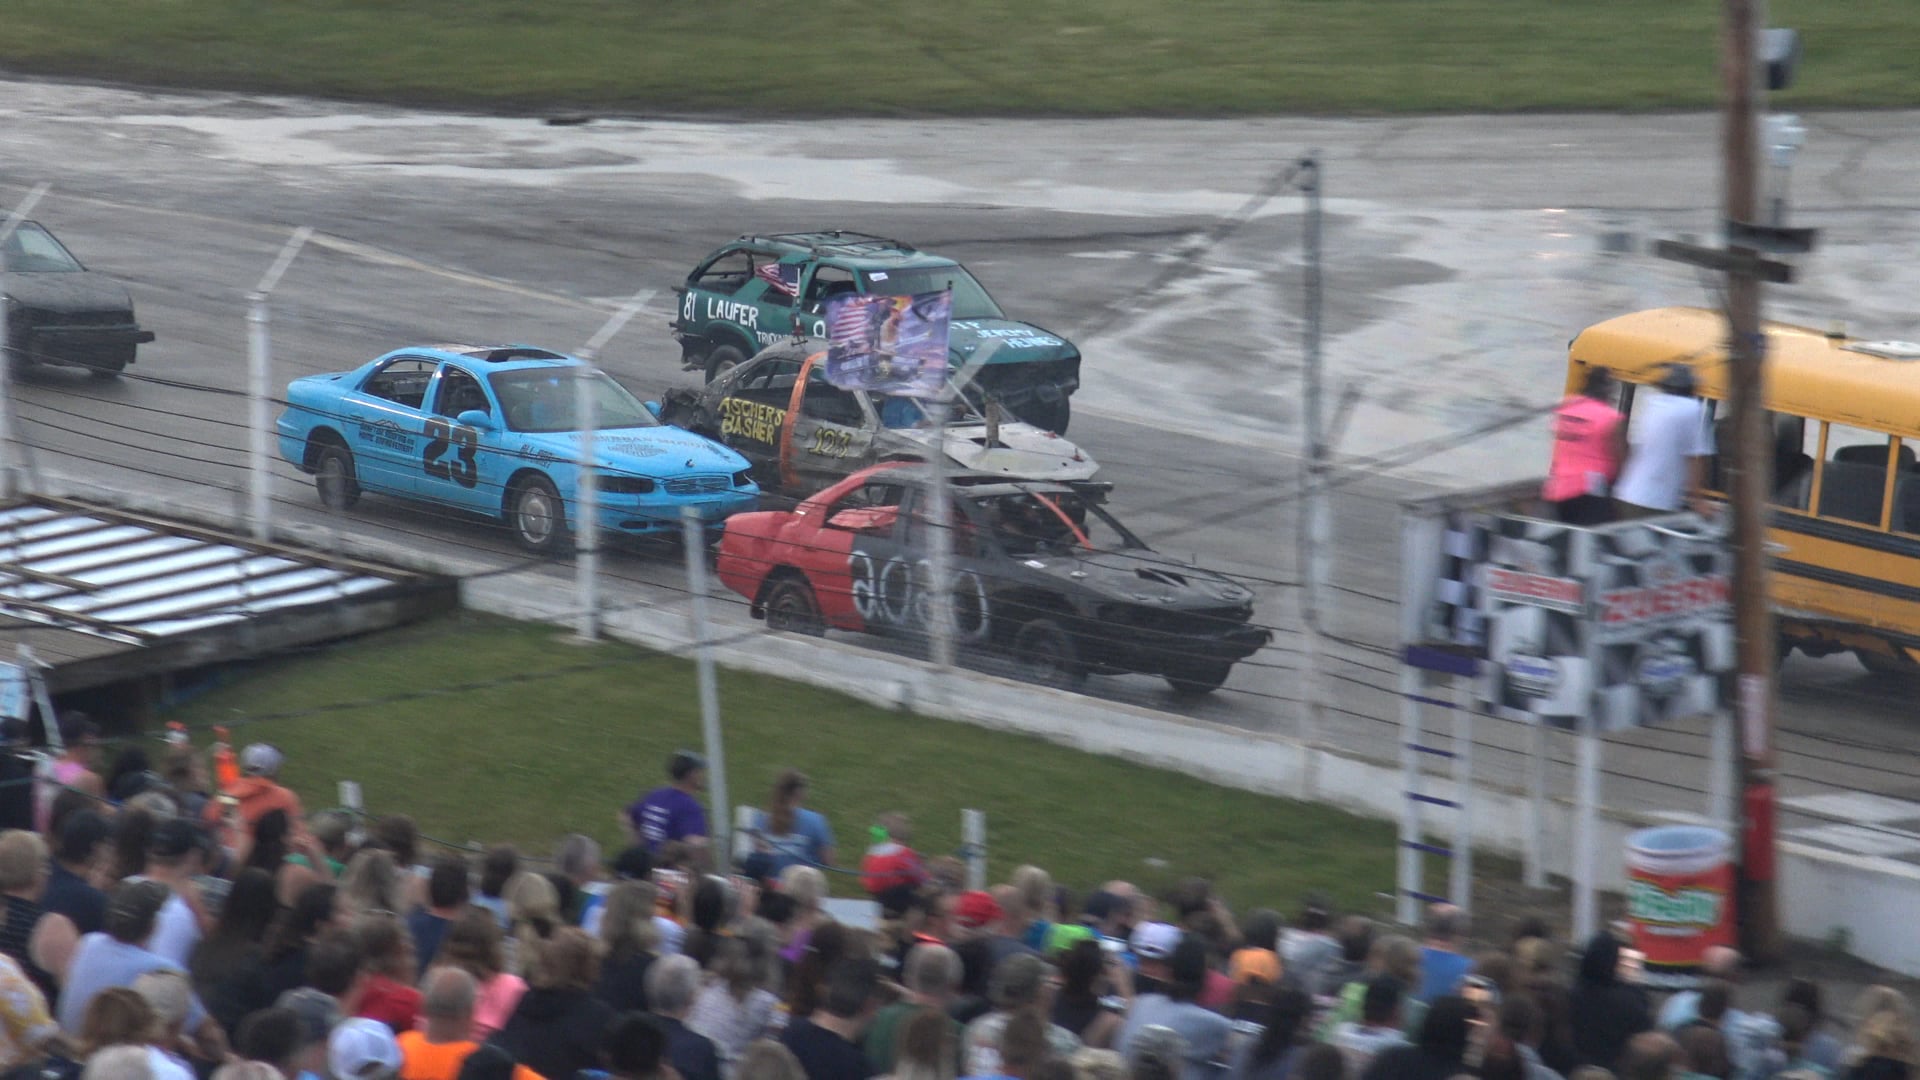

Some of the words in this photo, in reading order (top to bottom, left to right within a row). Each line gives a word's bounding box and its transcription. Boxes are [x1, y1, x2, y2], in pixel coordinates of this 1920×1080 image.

[683, 291, 697, 322] 81
[707, 297, 759, 330] LAUFER
[721, 413, 774, 446] BASHER
[423, 416, 477, 489] 23
